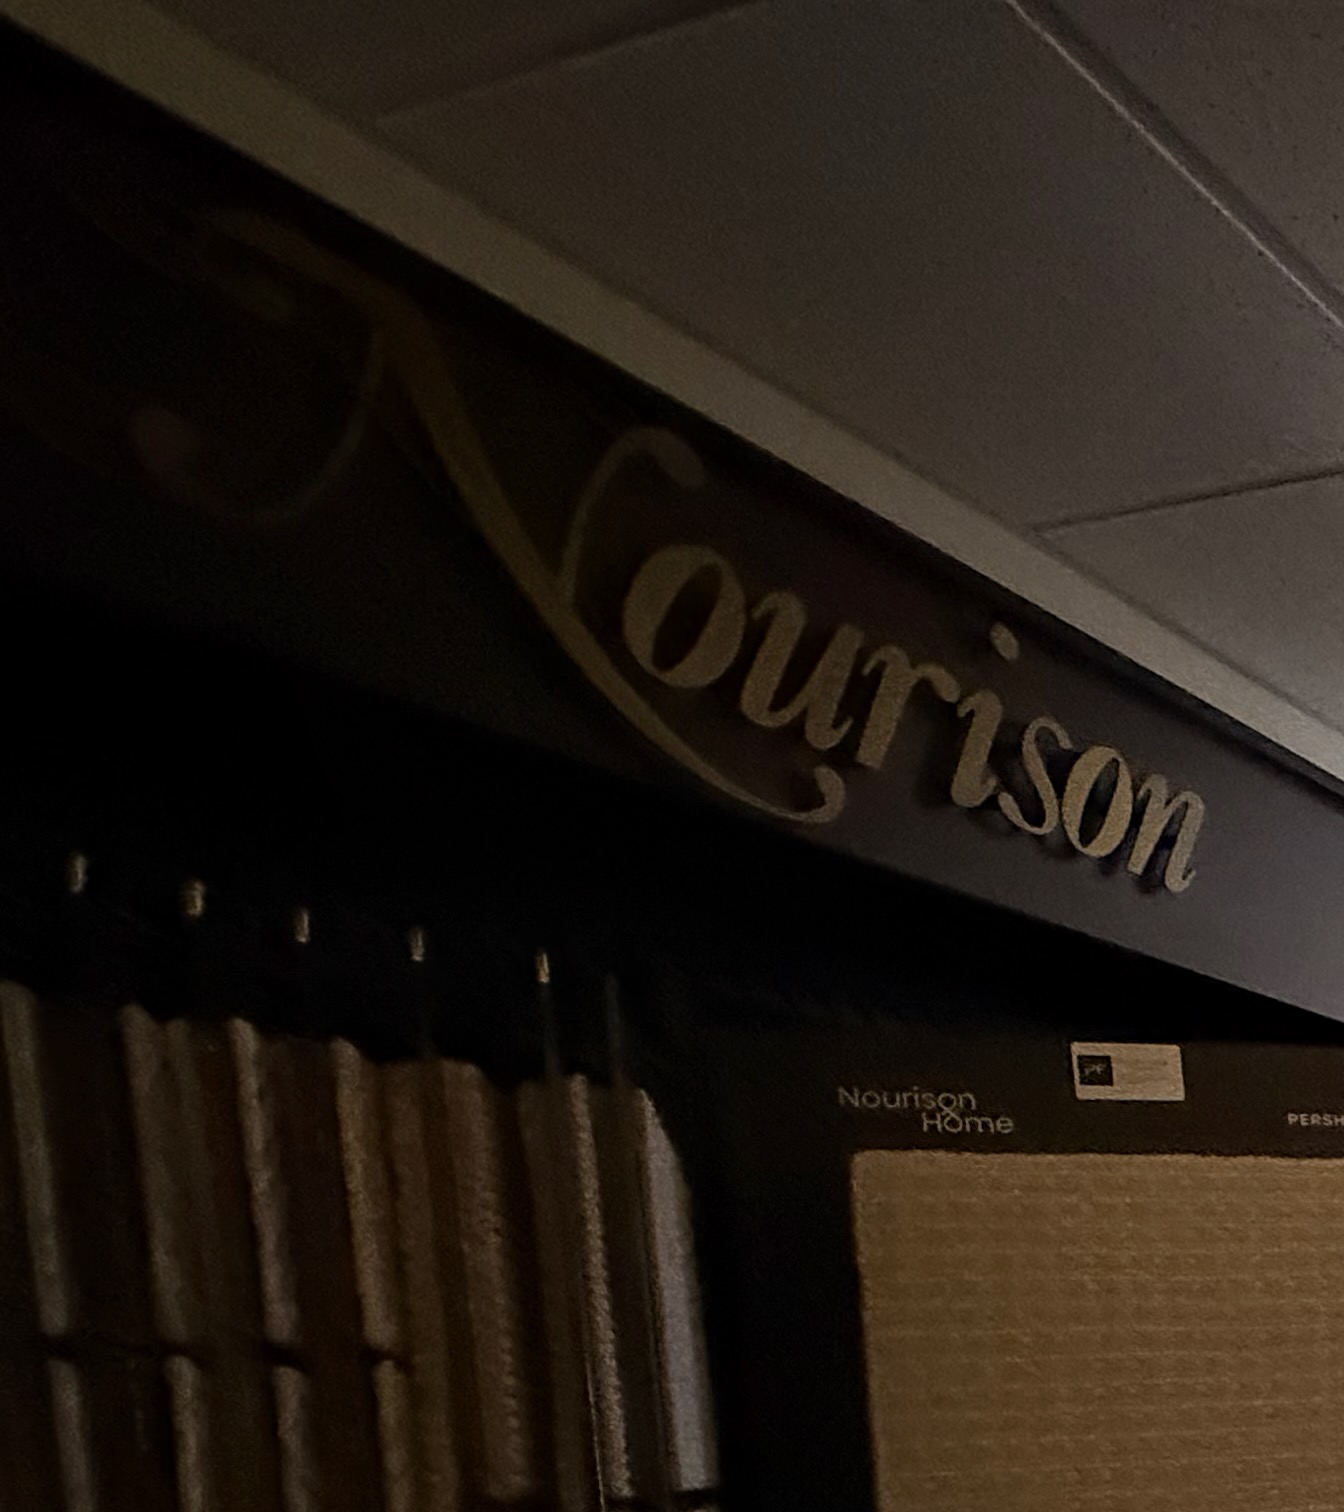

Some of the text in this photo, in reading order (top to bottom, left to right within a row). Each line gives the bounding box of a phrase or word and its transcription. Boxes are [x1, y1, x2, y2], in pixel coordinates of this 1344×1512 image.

[125, 202, 1207, 893] Nourison
[836, 1085, 978, 1112] Nourison
[921, 1111, 1015, 1135] Home
